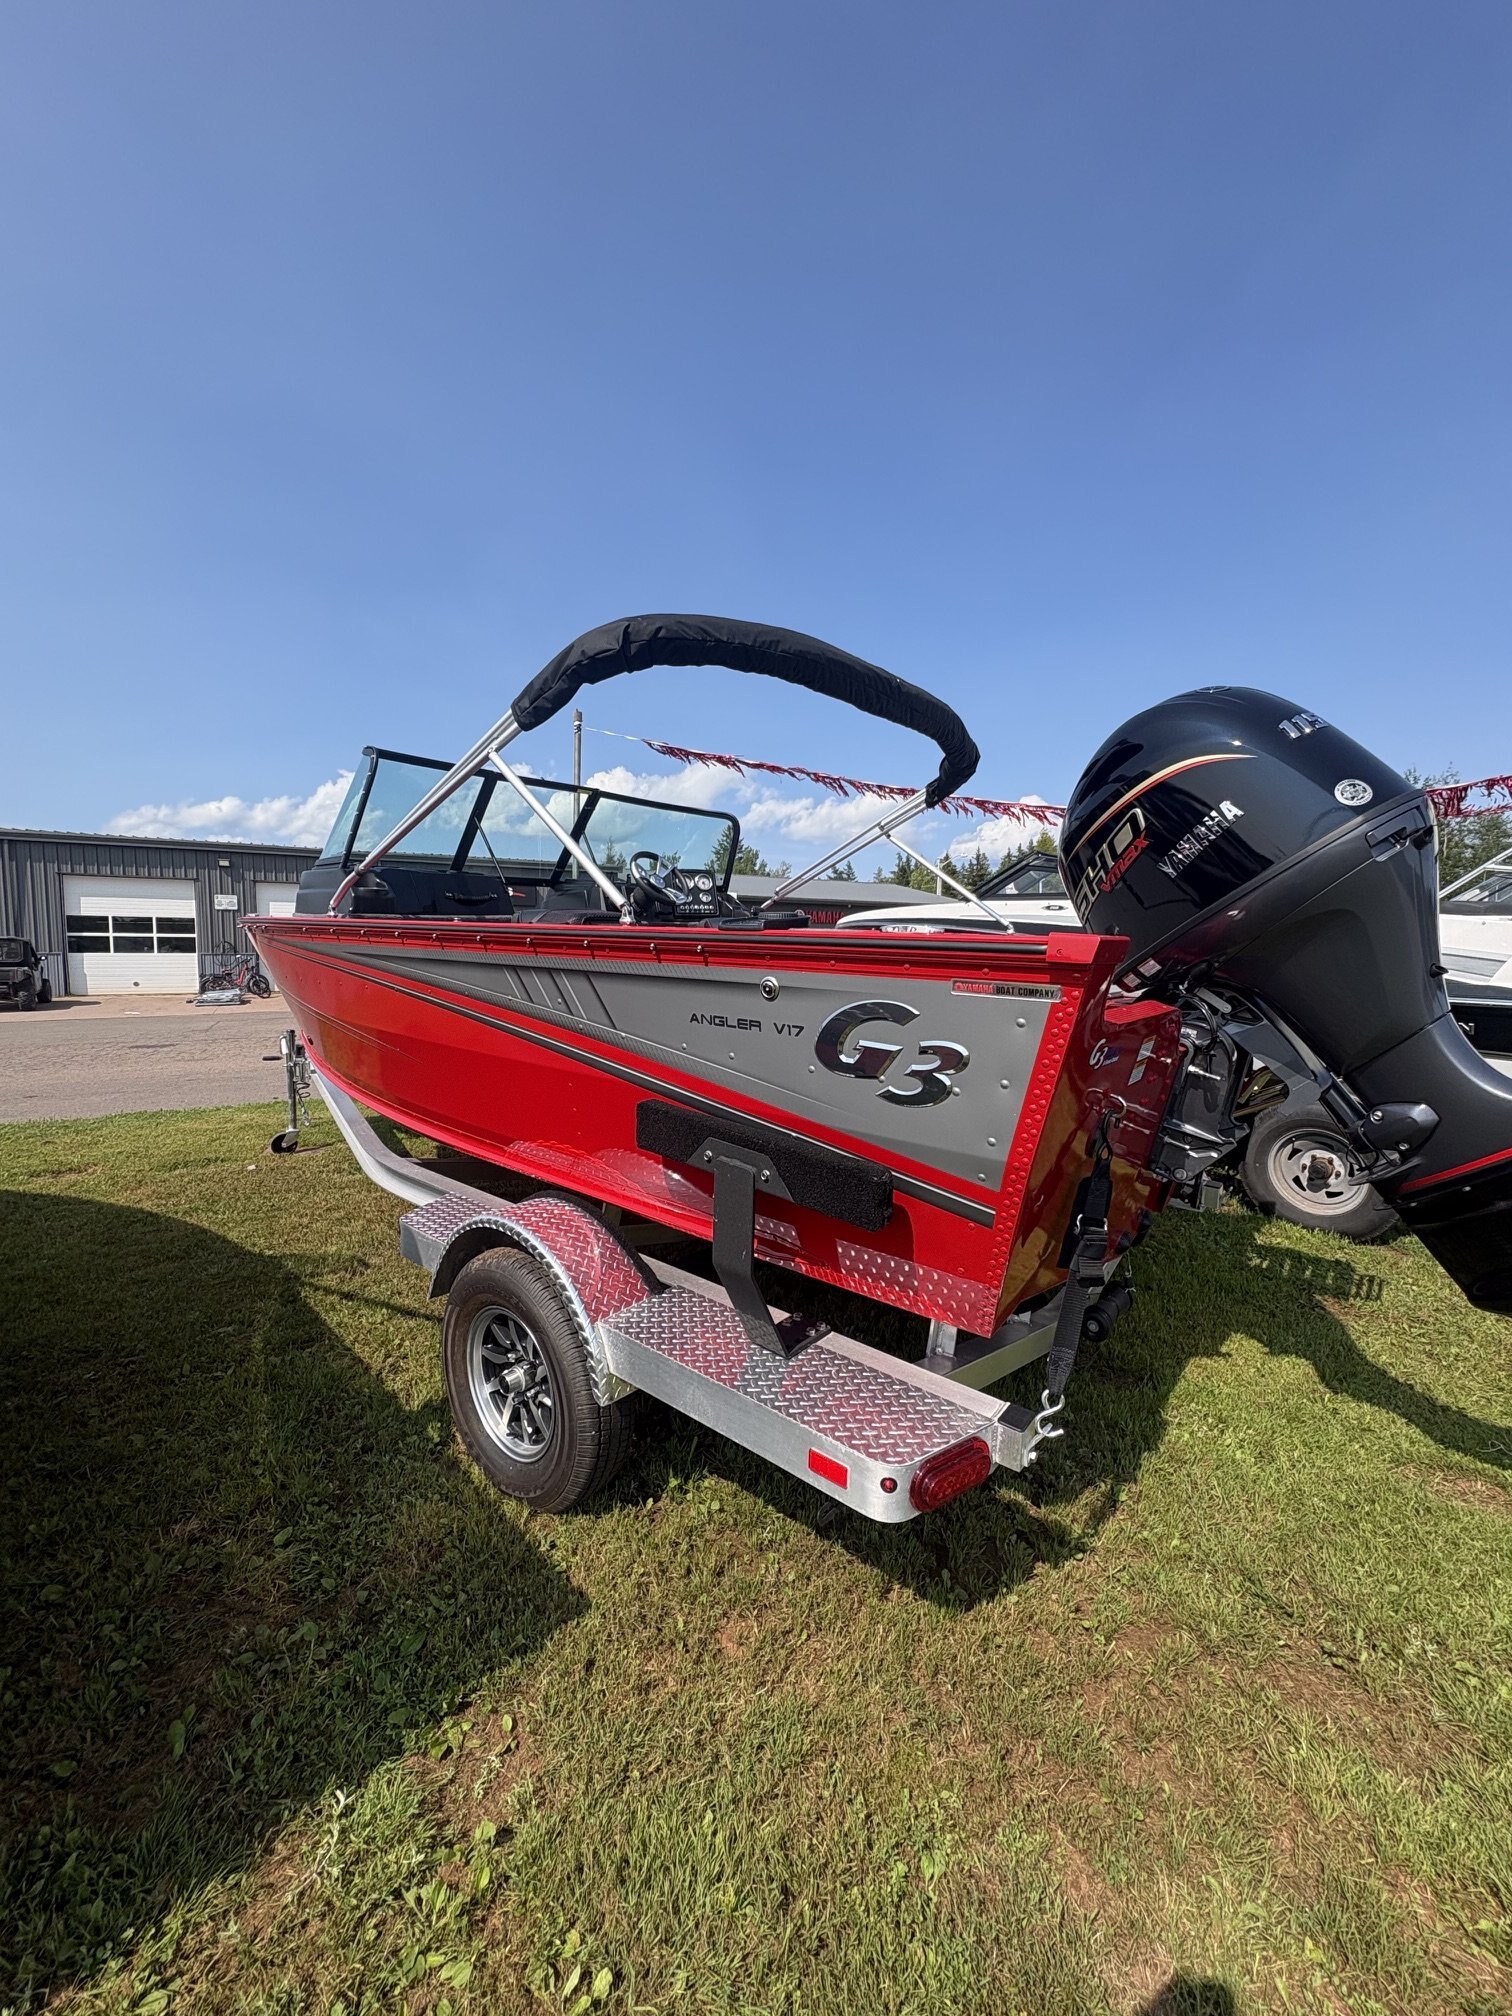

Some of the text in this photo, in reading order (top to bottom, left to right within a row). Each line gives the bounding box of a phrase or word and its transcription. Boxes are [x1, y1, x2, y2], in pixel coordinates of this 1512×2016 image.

[1279, 713, 1329, 739] 115
[1156, 800, 1246, 879] YAMAHA
[1073, 808, 1146, 925] SHO
[963, 983, 1055, 998] YAMAHA BOAT COMPANY
[689, 1012, 805, 1038] ANGLER V17
[814, 999, 971, 1109] G3
[1089, 1038, 1109, 1070] G3
